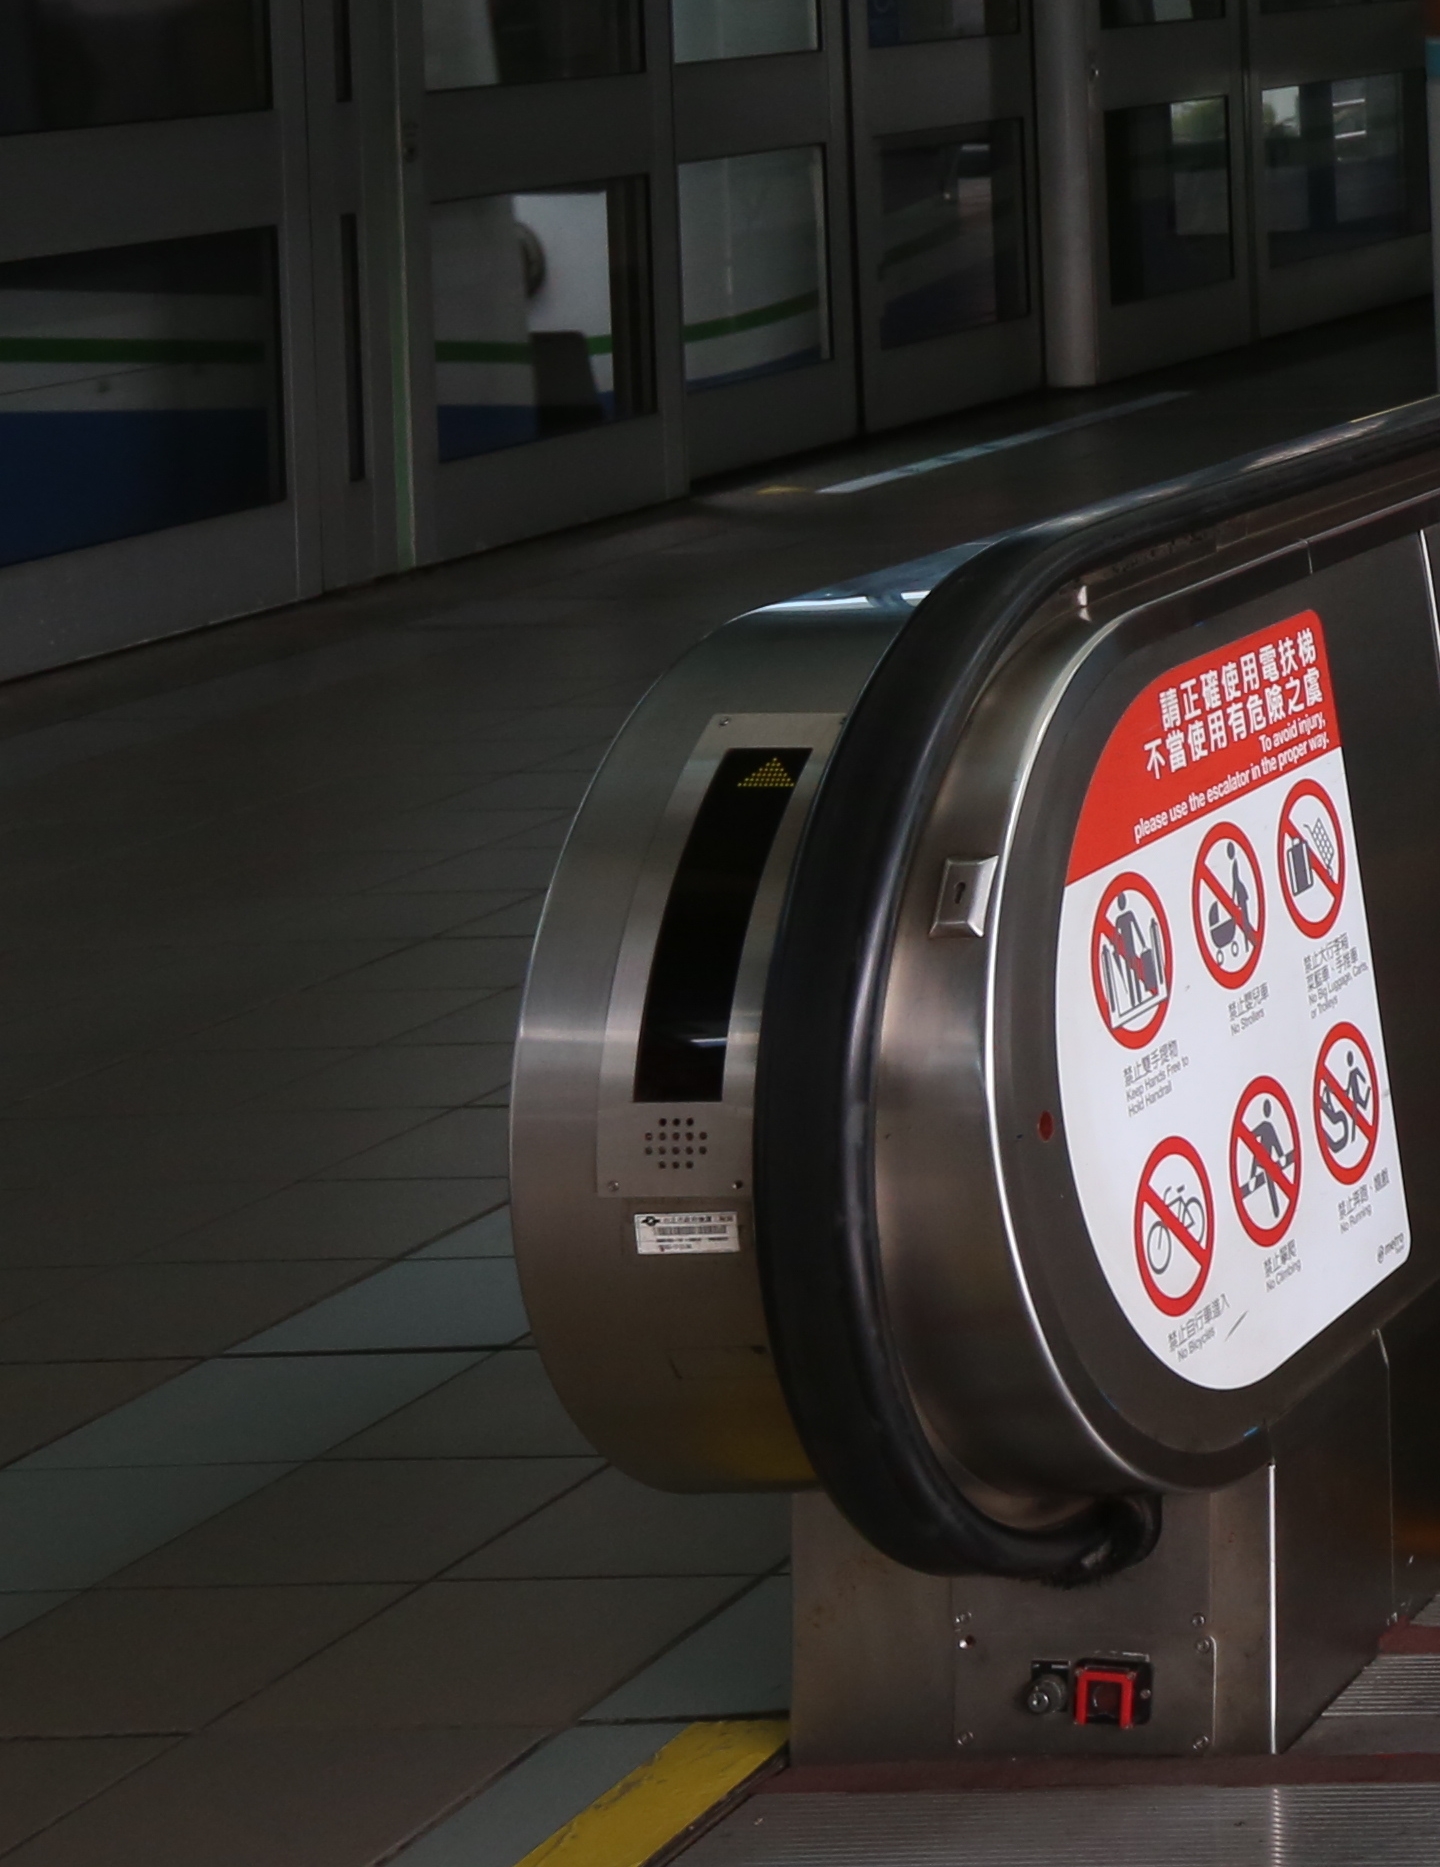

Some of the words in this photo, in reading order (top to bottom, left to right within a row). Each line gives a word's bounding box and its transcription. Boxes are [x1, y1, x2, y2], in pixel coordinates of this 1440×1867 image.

[1158, 626, 1317, 731] 請正確使用電扶梯
[1143, 665, 1323, 784] 不當使用有危險之虞
[1257, 731, 1272, 754] To
[1271, 719, 1297, 748] avoid
[1297, 707, 1326, 739] injury,
[1132, 806, 1168, 844] please
[1168, 799, 1188, 823] use
[1188, 787, 1207, 812] the
[1205, 765, 1250, 804] escalator
[1249, 760, 1261, 781] in
[1260, 752, 1277, 776] the
[1278, 739, 1309, 771] proper
[1307, 730, 1330, 756] way.
[1230, 1021, 1240, 1036] No
[1127, 1096, 1145, 1118] Hold
